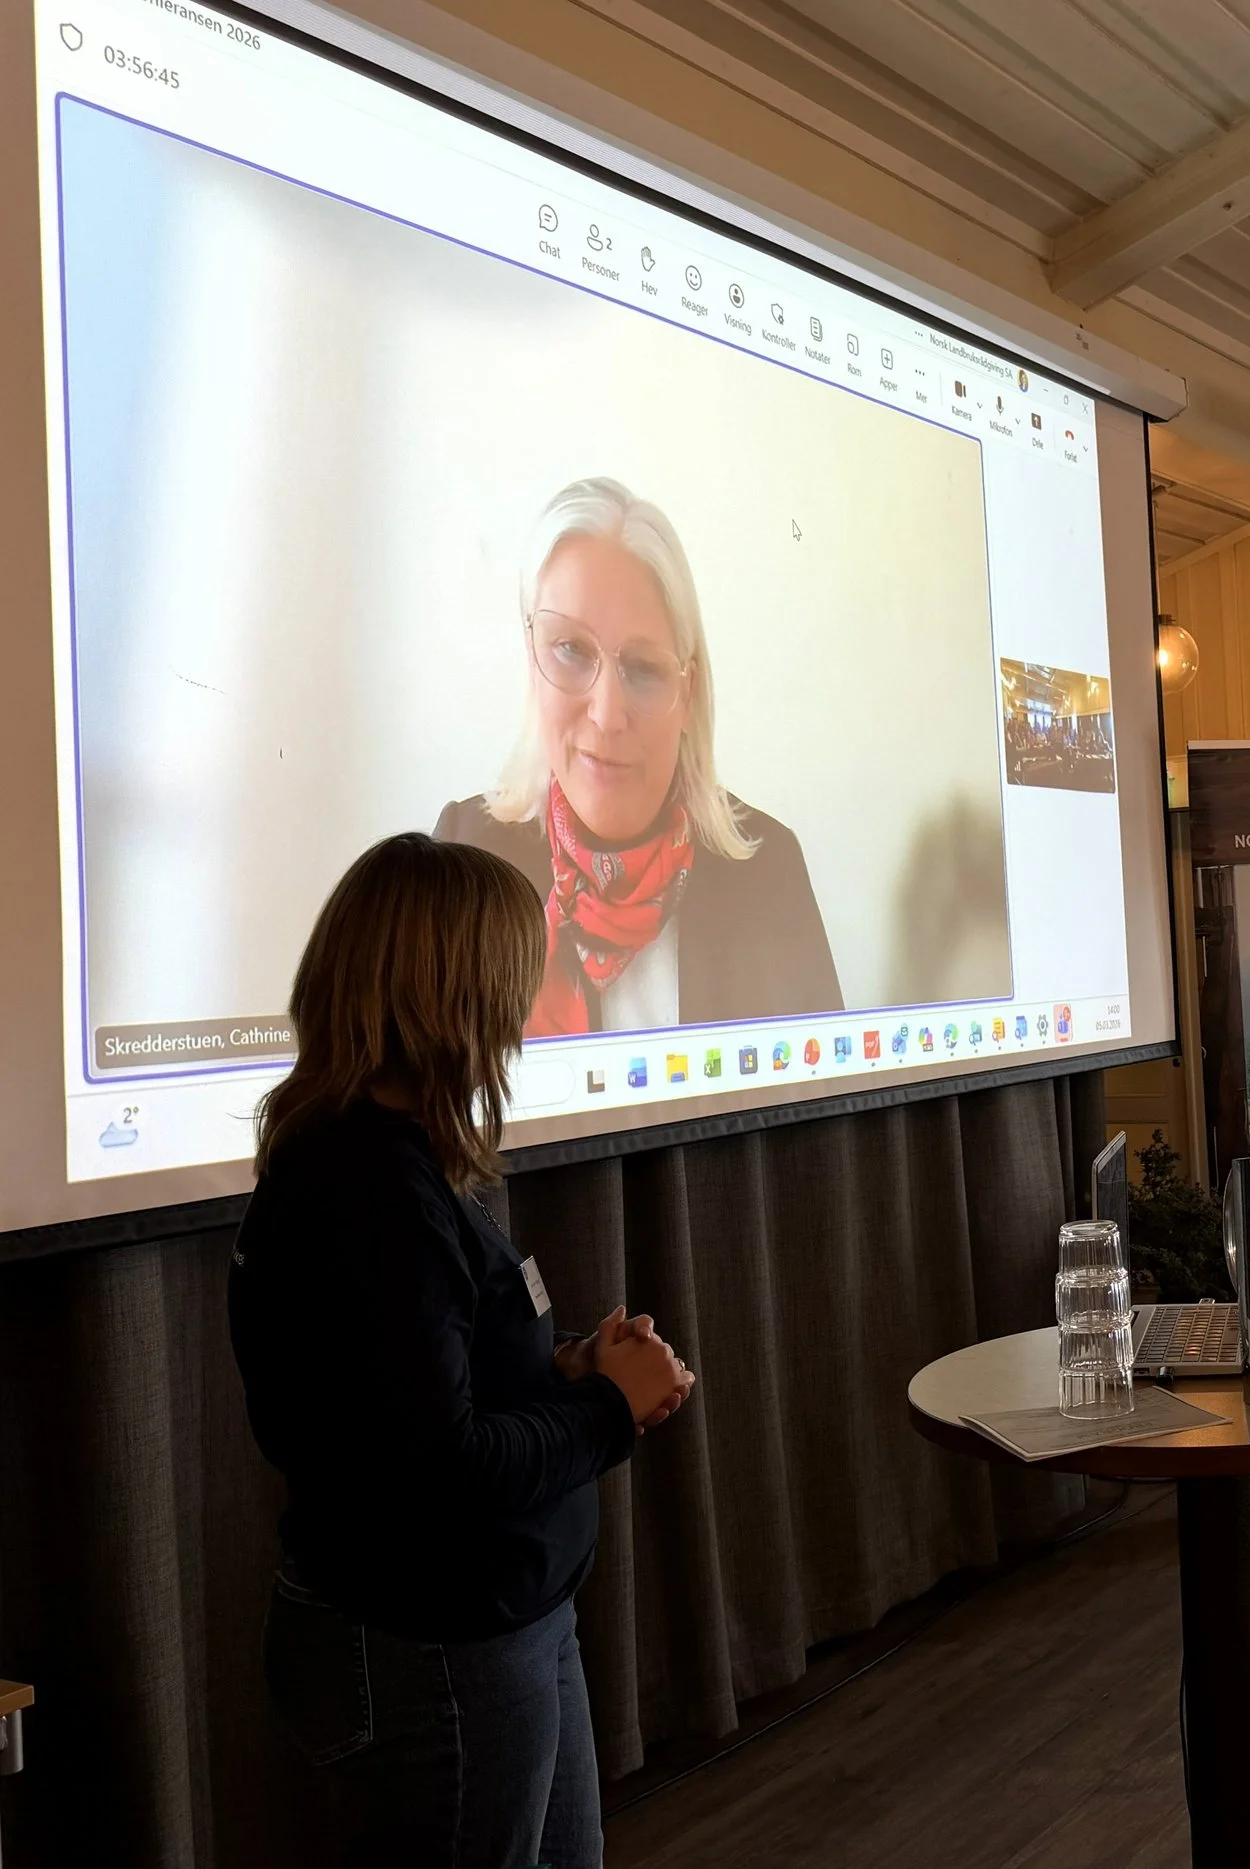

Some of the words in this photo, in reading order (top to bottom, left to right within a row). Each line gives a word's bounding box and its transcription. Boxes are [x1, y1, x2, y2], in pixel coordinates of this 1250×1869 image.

[226, 24, 261, 50] 2026
[104, 45, 180, 89] 03:56:45
[538, 240, 561, 259] Chat
[606, 237, 612, 251] 2
[582, 257, 620, 281] Personer
[641, 280, 658, 296] Hev
[681, 297, 708, 317] Reager
[724, 313, 752, 336] Visning
[762, 329, 796, 351] Kontroller
[805, 346, 831, 365] Notater
[930, 333, 948, 351] Norsk
[1005, 367, 1013, 379] SA
[847, 363, 862, 377] Rom
[880, 377, 898, 393] Apper
[916, 390, 928, 403] Mer
[951, 405, 972, 421] Kamera
[989, 420, 1013, 437] Mikrofon
[105, 1034, 225, 1056] Skredderstuen,
[230, 1027, 290, 1045] Cathrine
[629, 1073, 637, 1084] W
